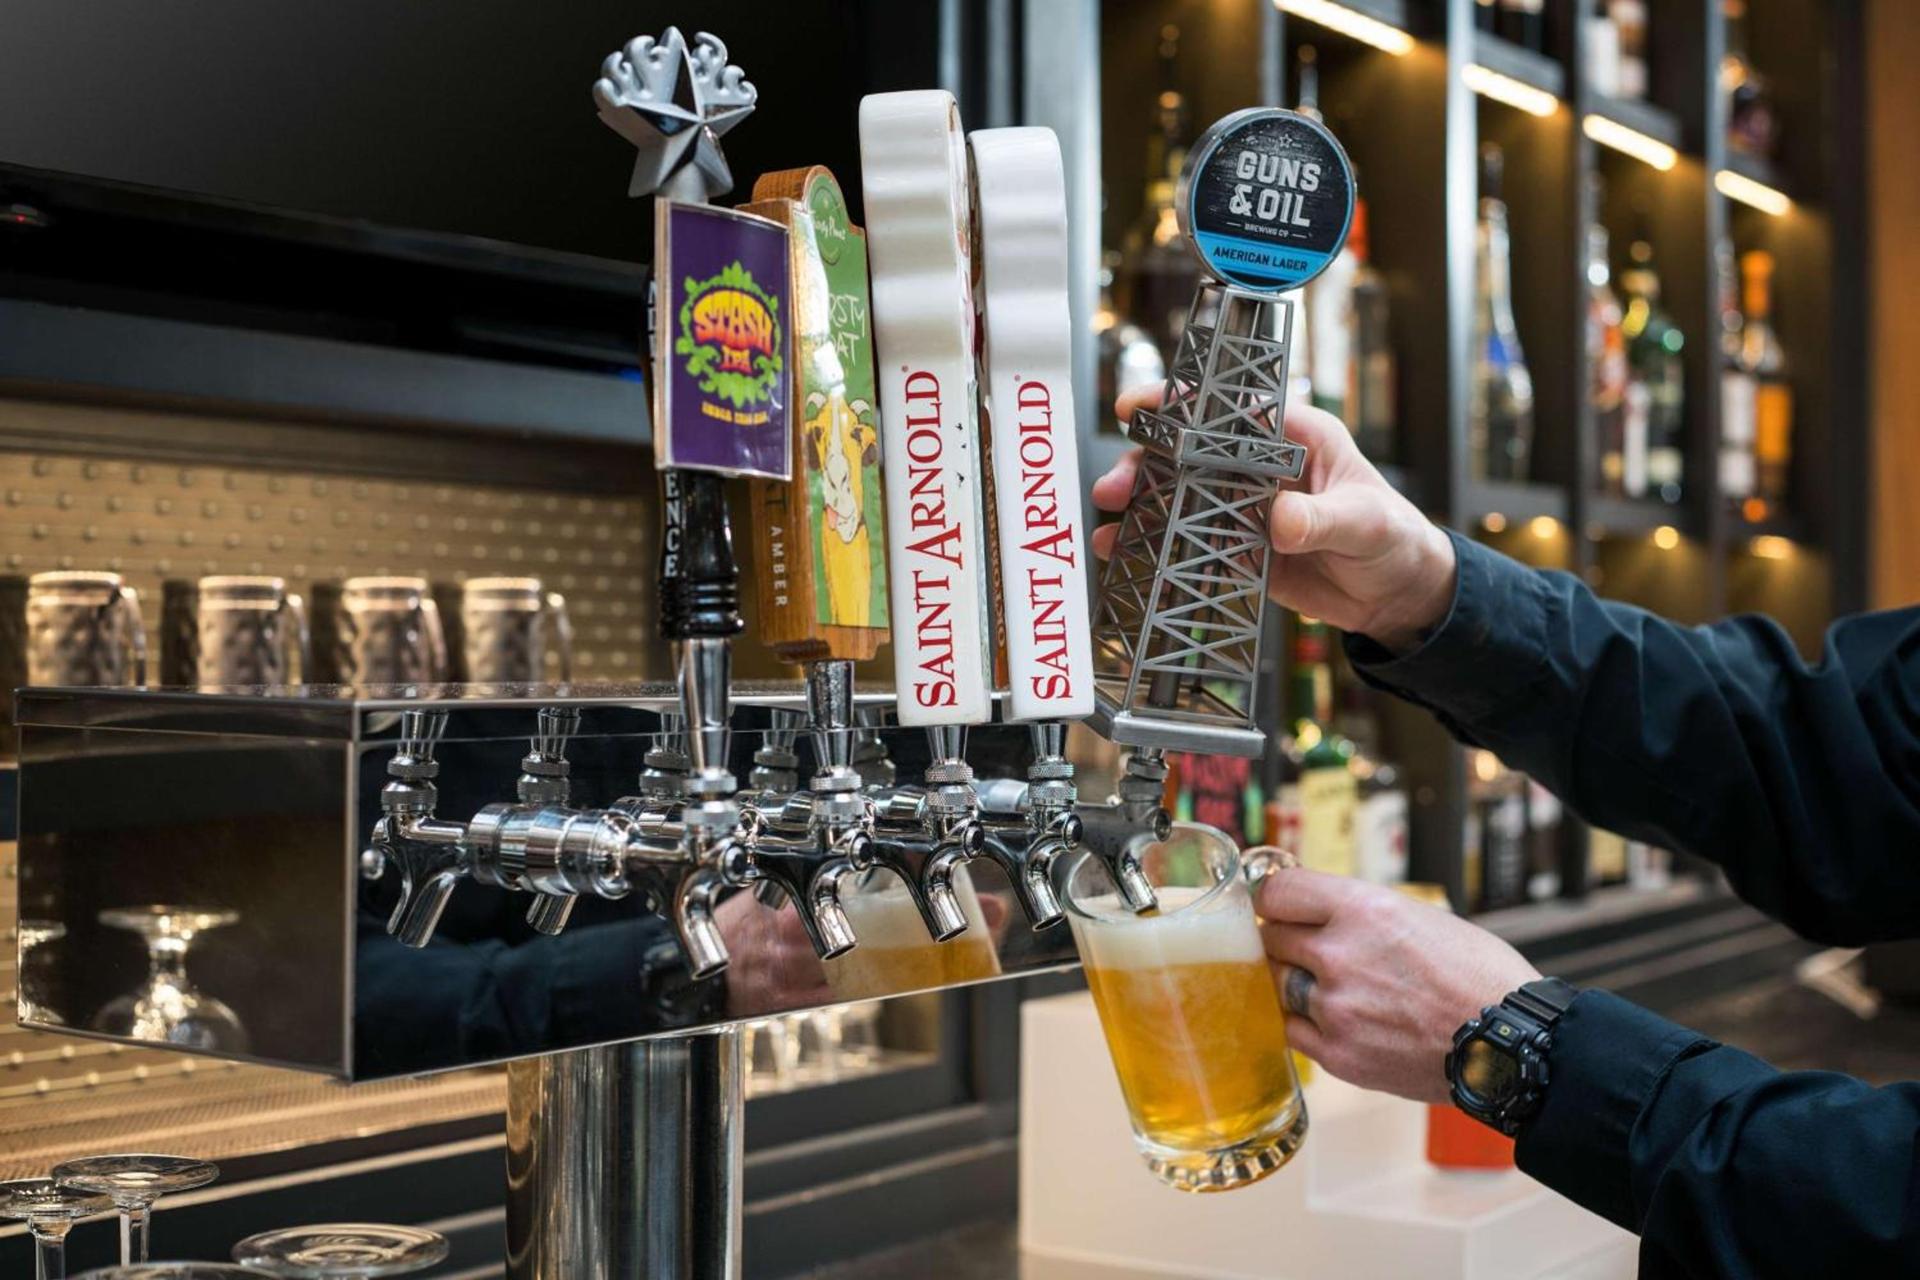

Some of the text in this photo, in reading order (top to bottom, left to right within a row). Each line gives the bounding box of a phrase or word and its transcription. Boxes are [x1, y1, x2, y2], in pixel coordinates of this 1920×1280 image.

[1236, 150, 1321, 192] GUNS
[1229, 183, 1311, 228] & OIL
[1214, 247, 1307, 272] AMERICAN LAGER
[693, 290, 773, 358] STASH
[719, 345, 752, 374] IPA
[770, 525, 788, 606] AMBER
[905, 371, 963, 707] SAINT ARNOLD
[1019, 382, 1074, 699] SAINT ARNOLD
